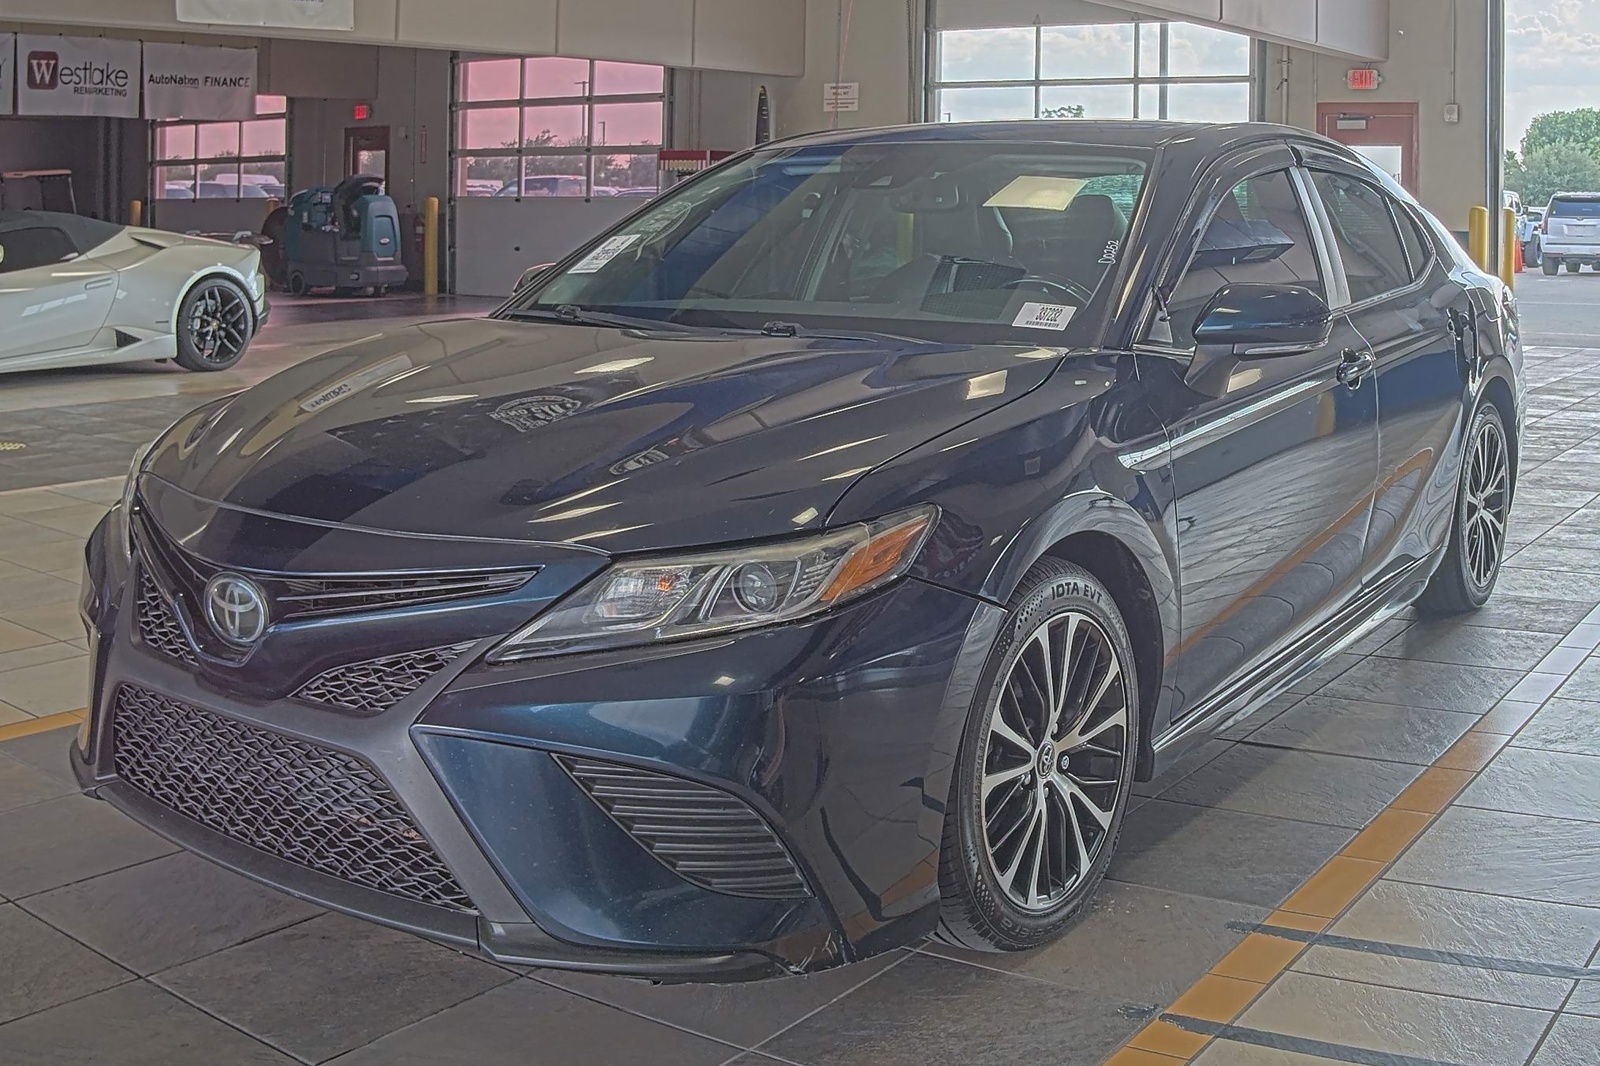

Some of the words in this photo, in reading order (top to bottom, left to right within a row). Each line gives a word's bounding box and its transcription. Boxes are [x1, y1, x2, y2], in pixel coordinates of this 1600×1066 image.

[30, 59, 129, 88] Westlake
[148, 73, 200, 86] AutoNation
[204, 75, 251, 88] FINANCE
[73, 86, 128, 98] REMARKETING
[1051, 581, 1080, 600] IOTA
[1083, 583, 1103, 604] EVT
